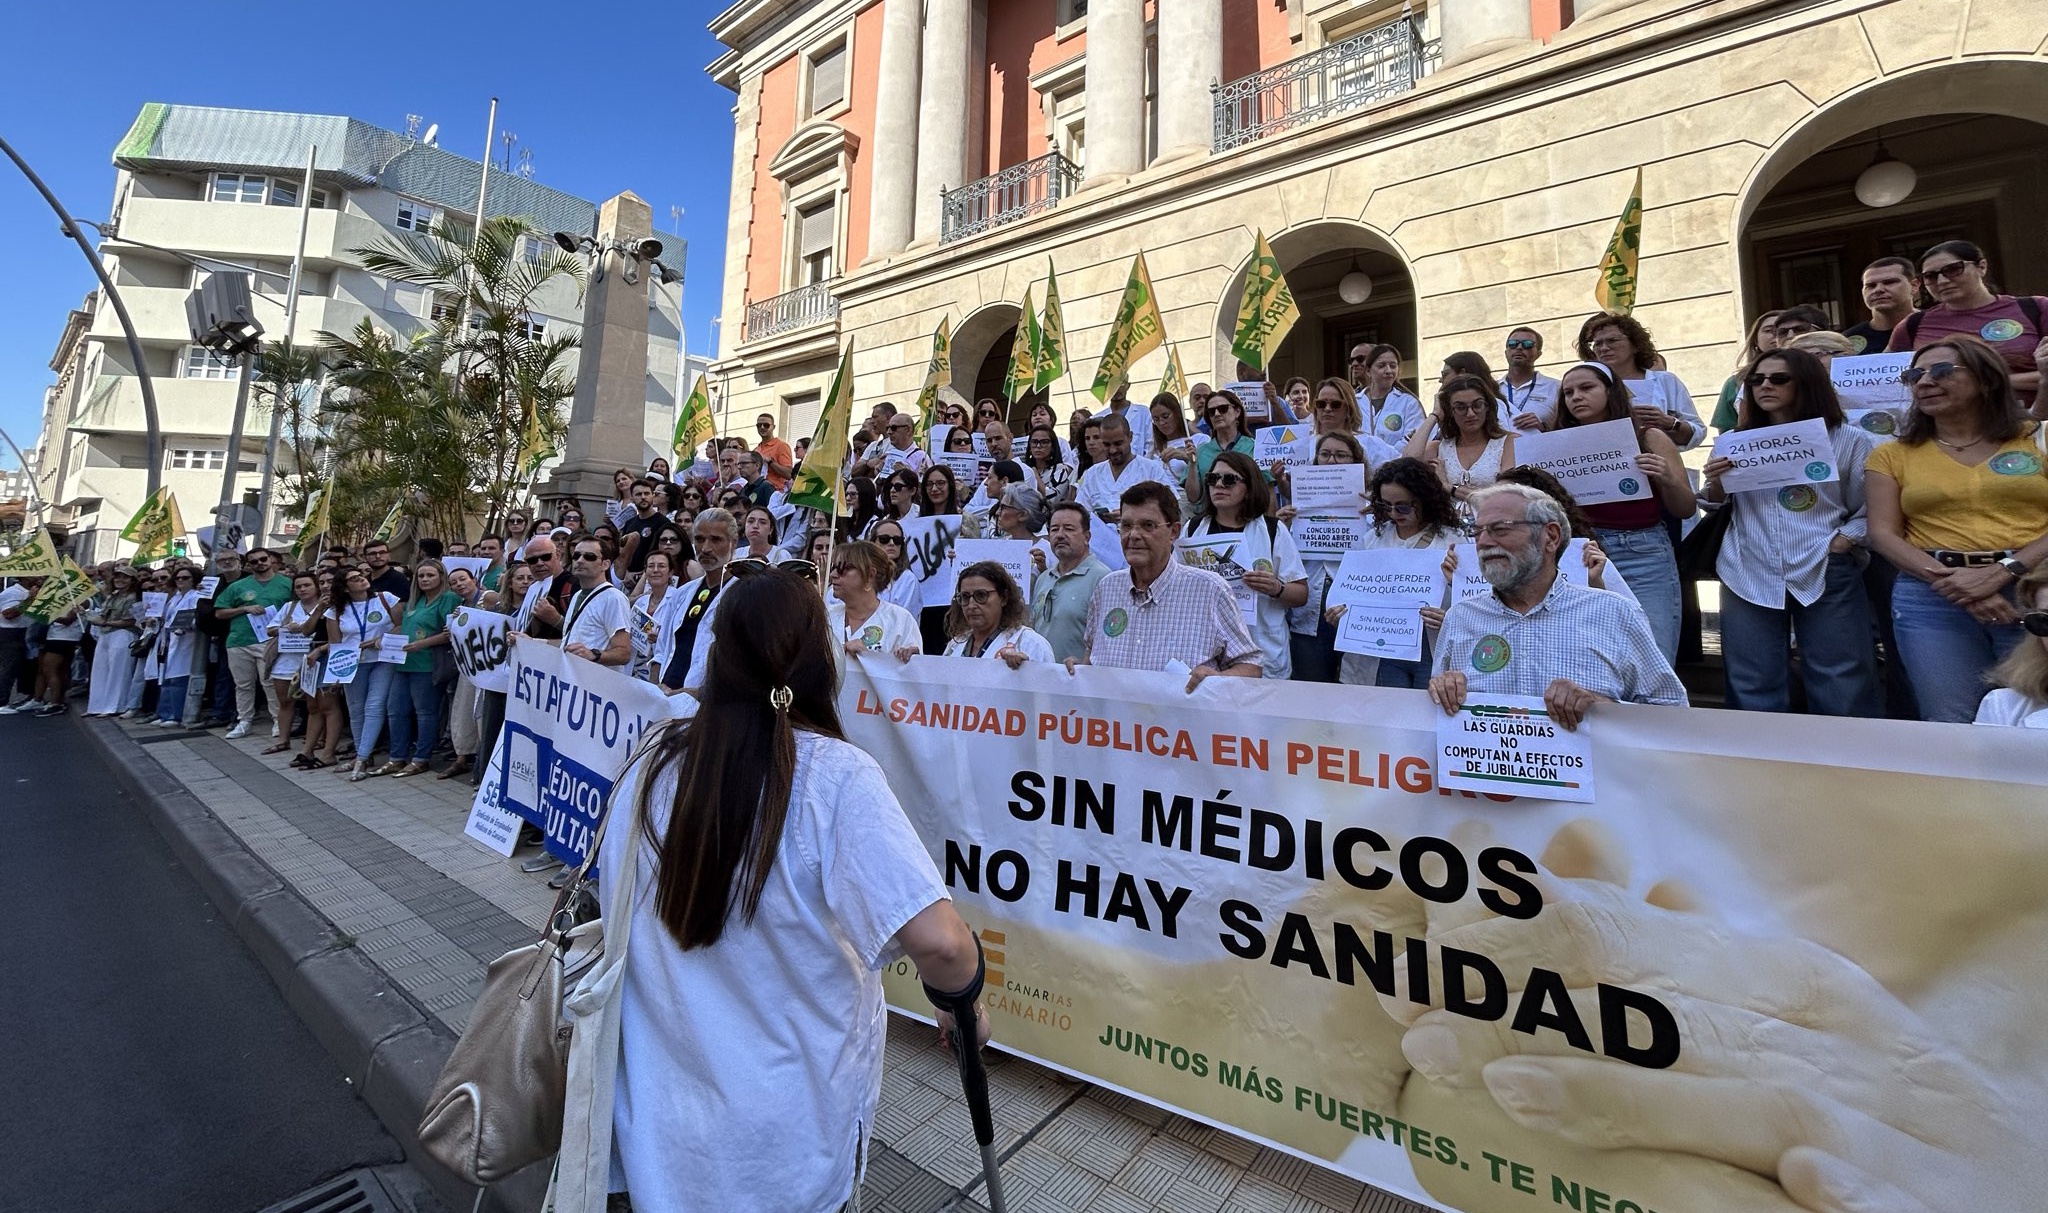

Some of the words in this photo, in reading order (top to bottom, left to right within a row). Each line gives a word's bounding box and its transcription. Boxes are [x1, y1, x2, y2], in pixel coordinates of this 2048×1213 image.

[1844, 368, 1867, 377] SIN
[1855, 378, 1883, 387] HAY
[1264, 446, 1296, 456] SEMCA
[1729, 444, 1746, 455] 24
[1748, 435, 1801, 452] HORAS
[1556, 457, 1578, 468] QUE
[1580, 450, 1623, 464] PERDER
[1760, 448, 1816, 466] MATAN
[1566, 468, 1590, 479] QUE
[1590, 462, 1630, 474] GANAR
[1299, 533, 1331, 541] TRASLADO
[1347, 574, 1373, 583] NADA
[1374, 575, 1394, 583] QUE
[1394, 574, 1431, 583] PERDER
[1340, 582, 1377, 594] MUCHO
[1378, 586, 1396, 595] QUE
[1397, 585, 1432, 594] GANAR
[1359, 615, 1372, 623] SIN
[1373, 614, 1408, 625] MÉDICOS
[1350, 623, 1363, 631] NO
[1364, 625, 1381, 634] HAY
[1381, 627, 1415, 636] SANIDAD
[514, 661, 620, 749] ESTATUTO
[889, 698, 1026, 737] SANIDAD
[1038, 708, 1199, 762] PÚBLICA
[1211, 733, 1270, 772] EN
[1463, 720, 1487, 733] LAS
[1490, 722, 1555, 738] GUARDIAS
[1500, 737, 1518, 749] NO
[1444, 745, 1511, 763] COMPUTAN
[1513, 751, 1522, 764] A
[1526, 752, 1584, 768] EFECTOS
[1466, 760, 1482, 773] DE
[1485, 762, 1558, 780] JUBILACIÓN
[1007, 769, 1117, 836] SIN
[1141, 788, 1544, 920] MÉDICOS
[944, 838, 1031, 902] NO
[1054, 858, 1194, 940] HAY
[1218, 898, 1682, 1070] SANIDAD
[1006, 980, 1073, 1008] CANARIAS
[986, 992, 1073, 1032] CANARIO
[1098, 1024, 1210, 1079] JUNTOS
[1218, 1065, 1285, 1104] MÁS
[1294, 1085, 1471, 1172] FUERTES.
[1481, 1151, 1537, 1196] TE
